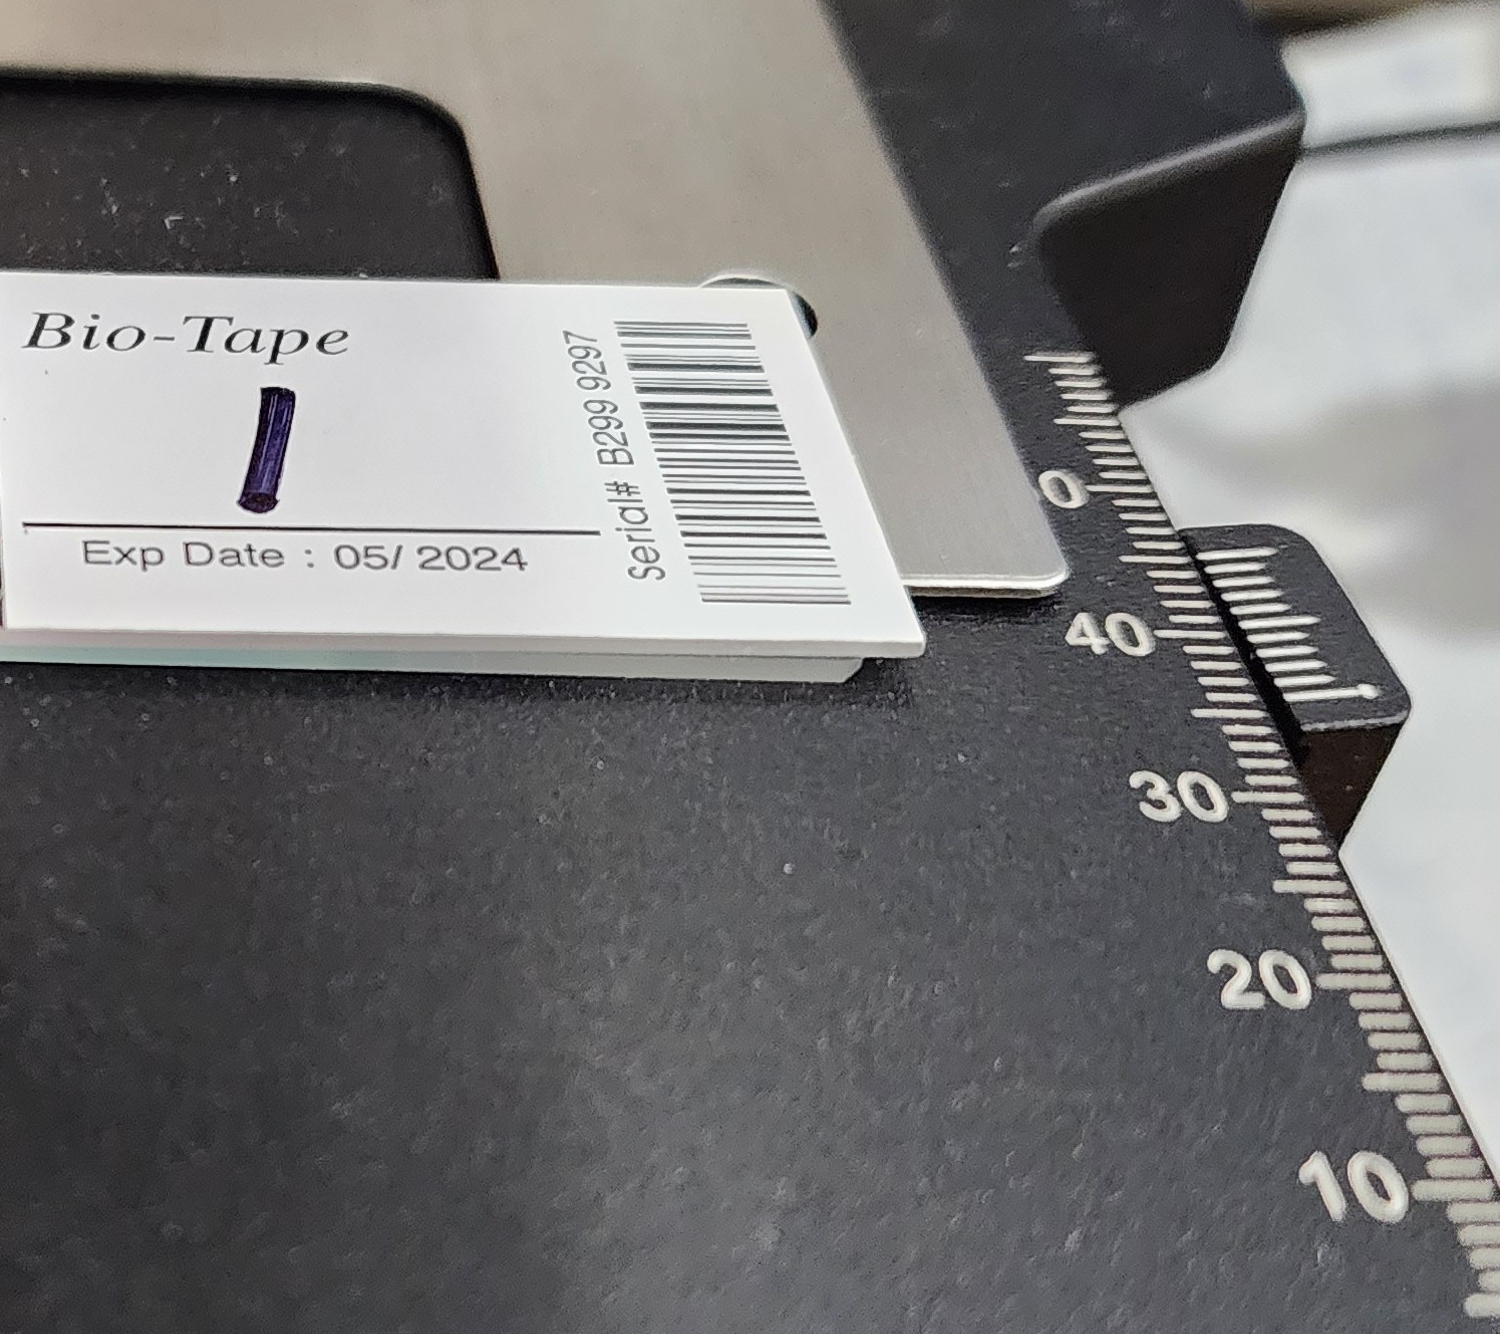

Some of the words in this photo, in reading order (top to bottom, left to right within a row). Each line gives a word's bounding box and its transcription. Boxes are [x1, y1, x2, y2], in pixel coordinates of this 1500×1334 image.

[21, 312, 349, 365] Bio-Tape
[562, 329, 612, 391] 9297
[583, 398, 635, 466] B299
[82, 540, 165, 572] Exp
[183, 541, 285, 568] Date
[417, 545, 528, 572] 2024
[604, 480, 666, 582] Serial#
[1064, 612, 1156, 657] 40
[1129, 770, 1229, 823] 30
[1207, 949, 1312, 1010] 20
[1298, 1150, 1409, 1224] 10
